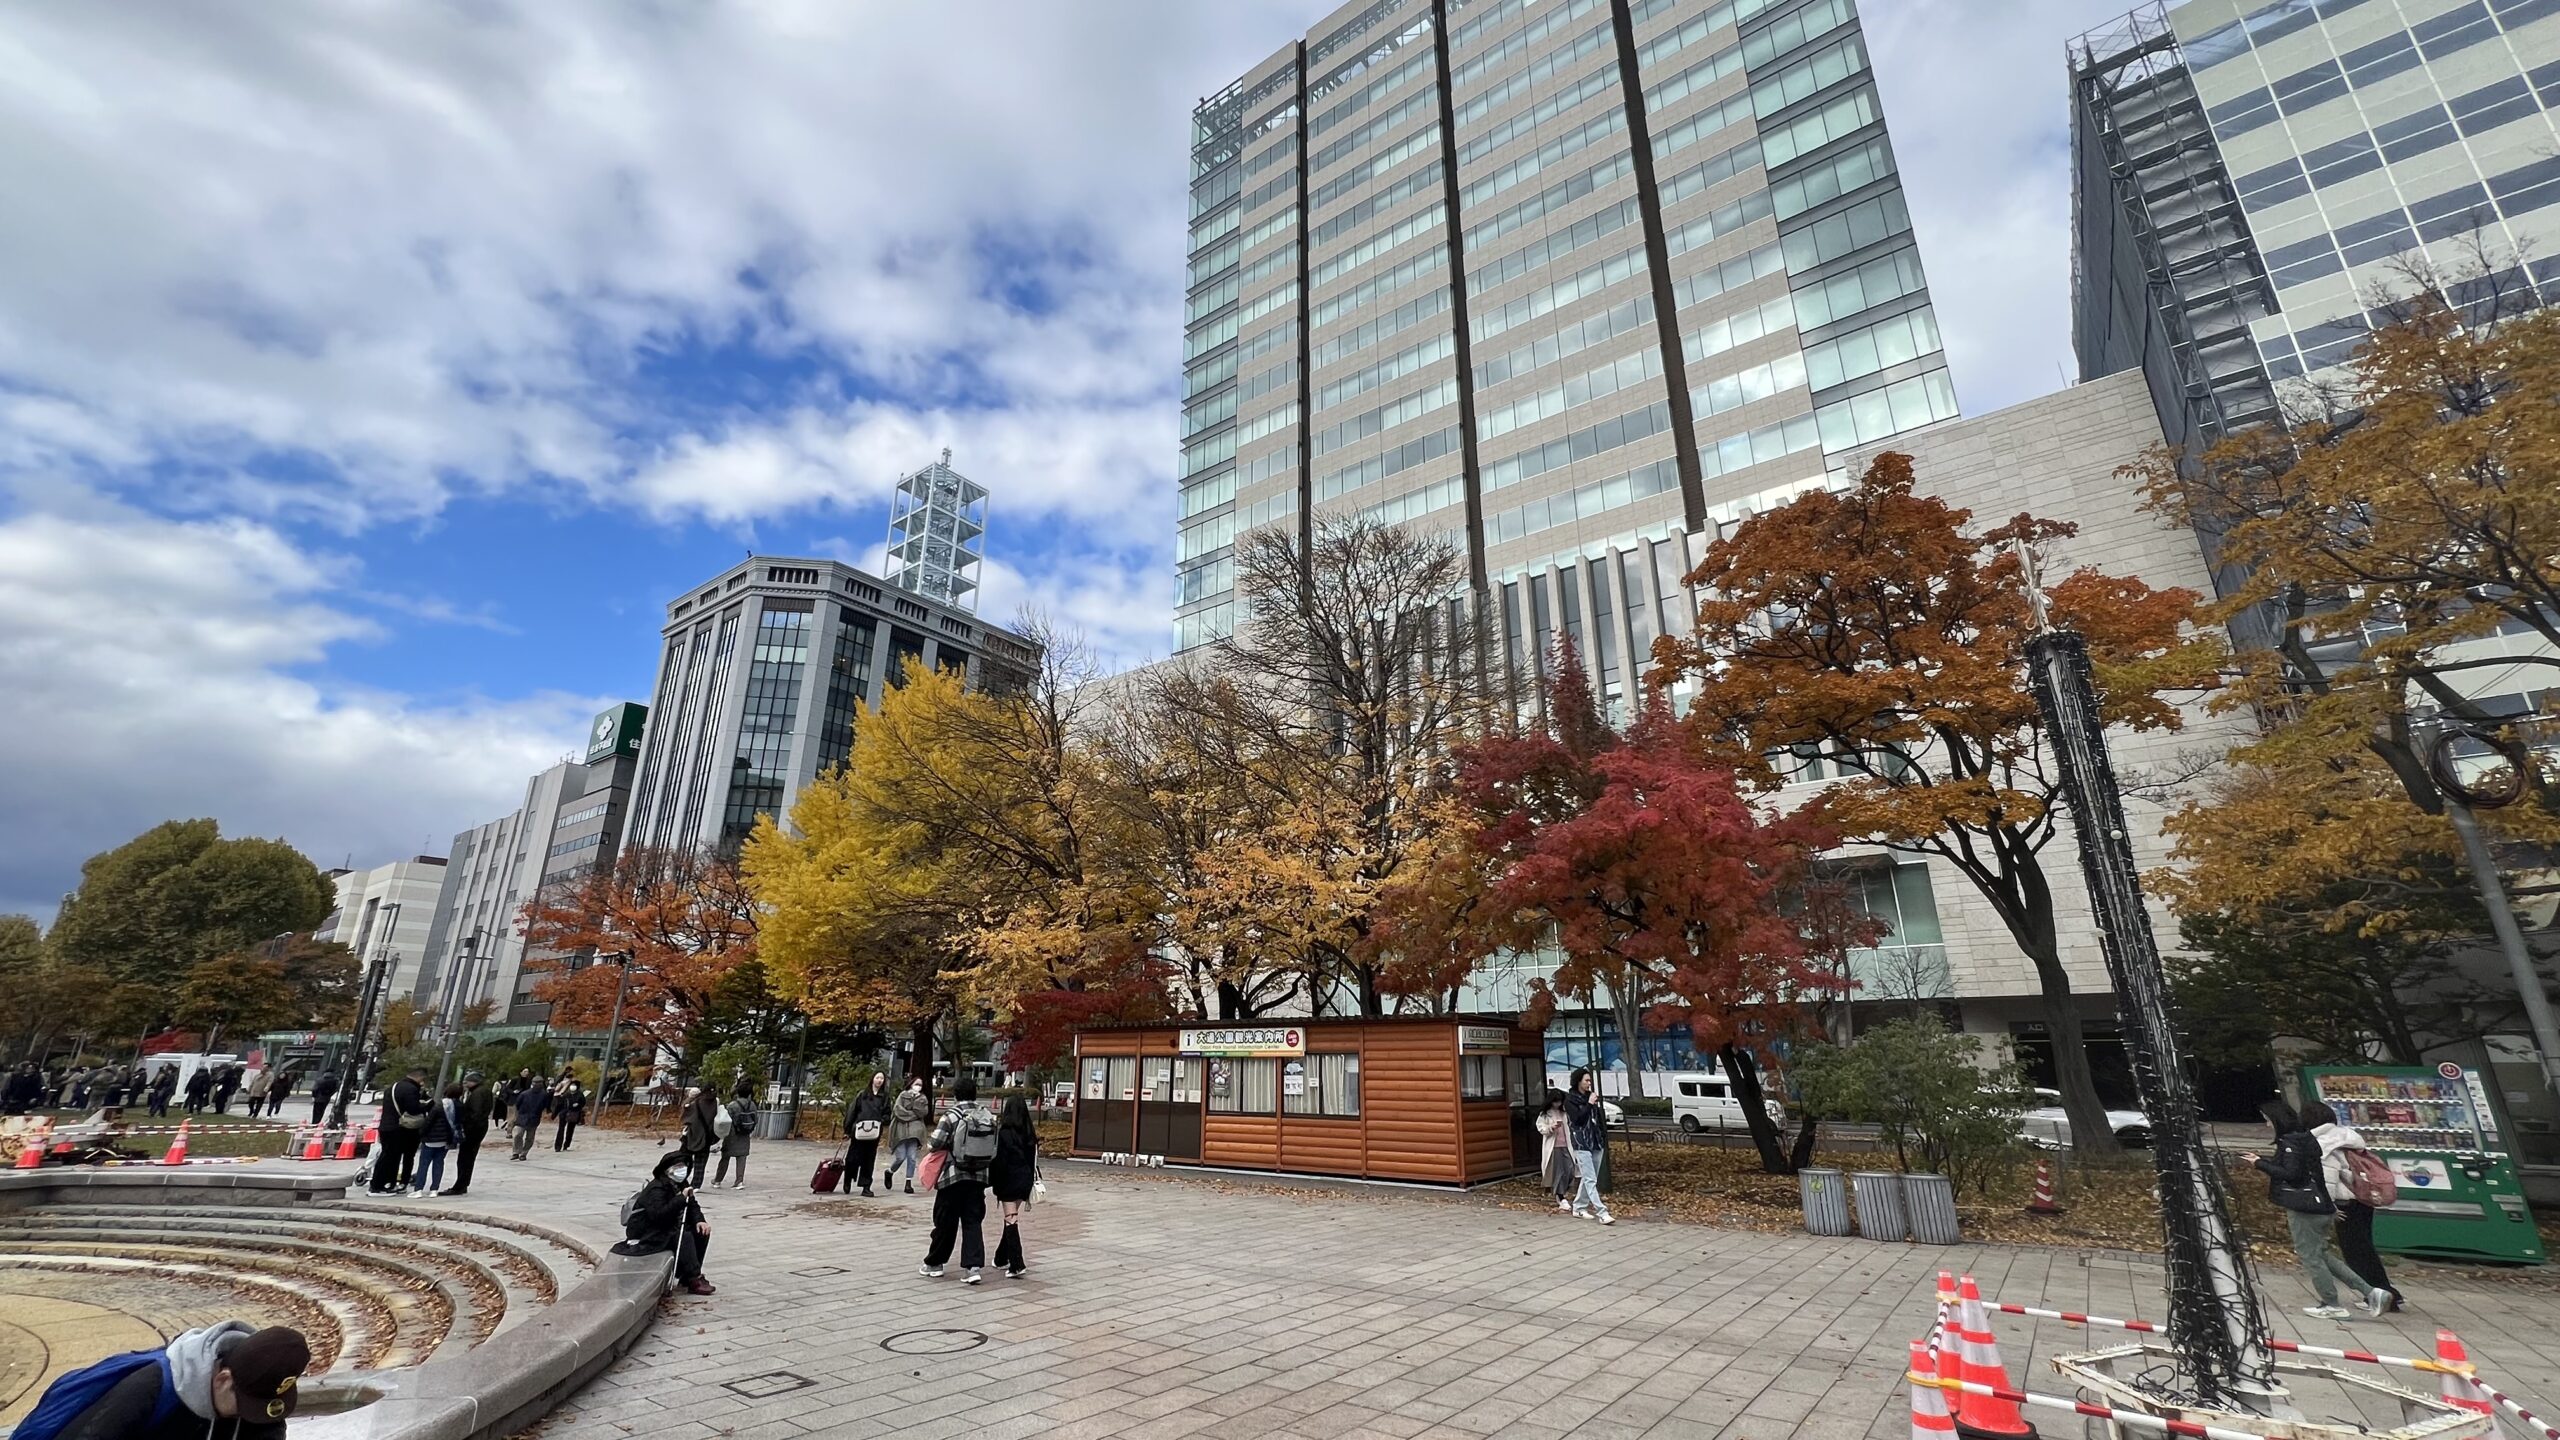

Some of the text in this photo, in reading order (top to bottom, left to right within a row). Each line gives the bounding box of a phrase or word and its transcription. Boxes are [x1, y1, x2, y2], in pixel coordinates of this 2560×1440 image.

[1196, 1030, 1285, 1044] 大通公園観光案内所
